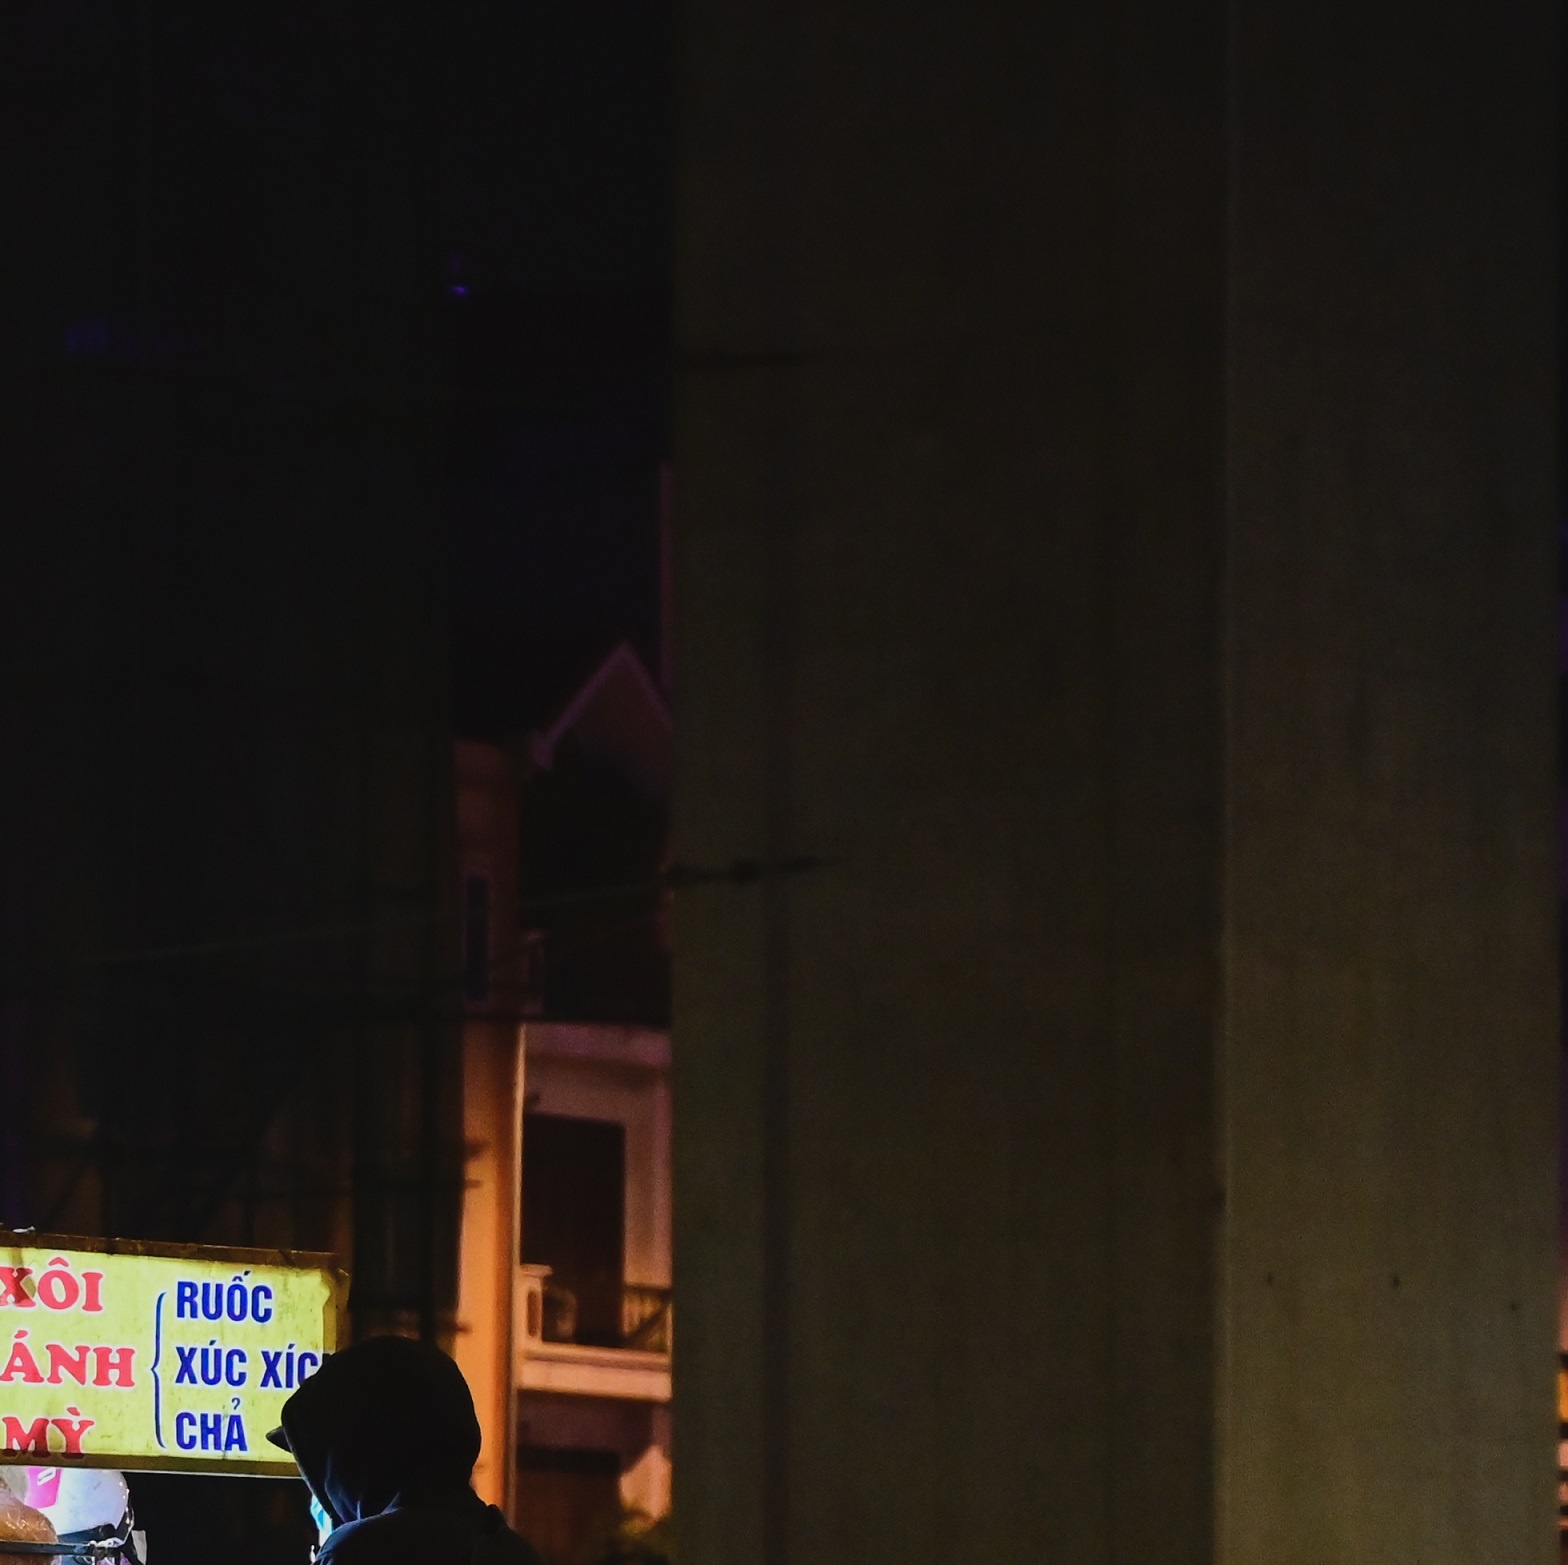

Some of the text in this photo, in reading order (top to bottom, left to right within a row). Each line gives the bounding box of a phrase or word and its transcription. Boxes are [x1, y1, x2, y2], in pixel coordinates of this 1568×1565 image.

[176, 1270, 273, 1324] RUỐC
[175, 1339, 331, 1388] XÚC XÍC
[2, 1406, 95, 1458] MỲ
[175, 1397, 248, 1452] CHẢ
